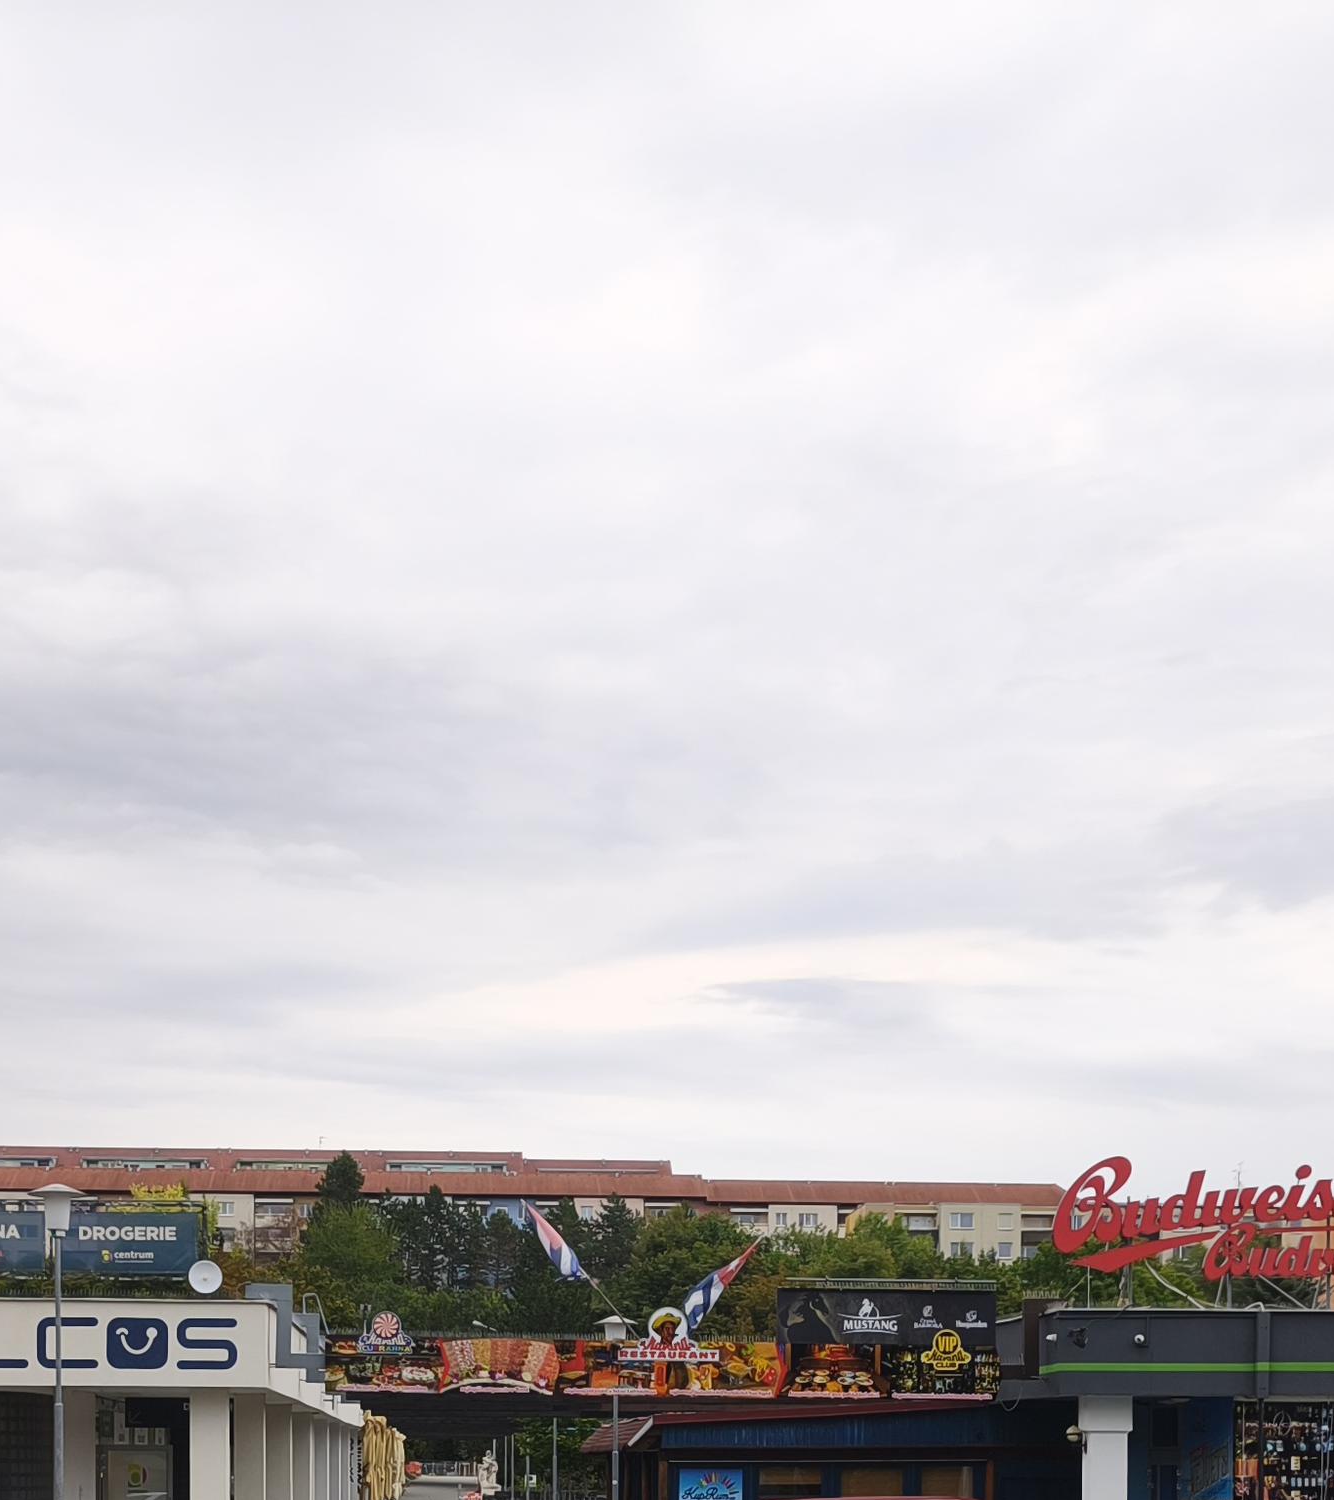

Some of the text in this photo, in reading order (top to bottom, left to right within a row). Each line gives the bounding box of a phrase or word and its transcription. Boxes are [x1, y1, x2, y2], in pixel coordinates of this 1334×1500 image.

[78, 1226, 177, 1241] DROGERIE
[113, 1250, 155, 1260] centrum
[843, 1319, 898, 1332] MUSTANG
[937, 1335, 957, 1352] VIP
[619, 1350, 718, 1360] RESTAURANT
